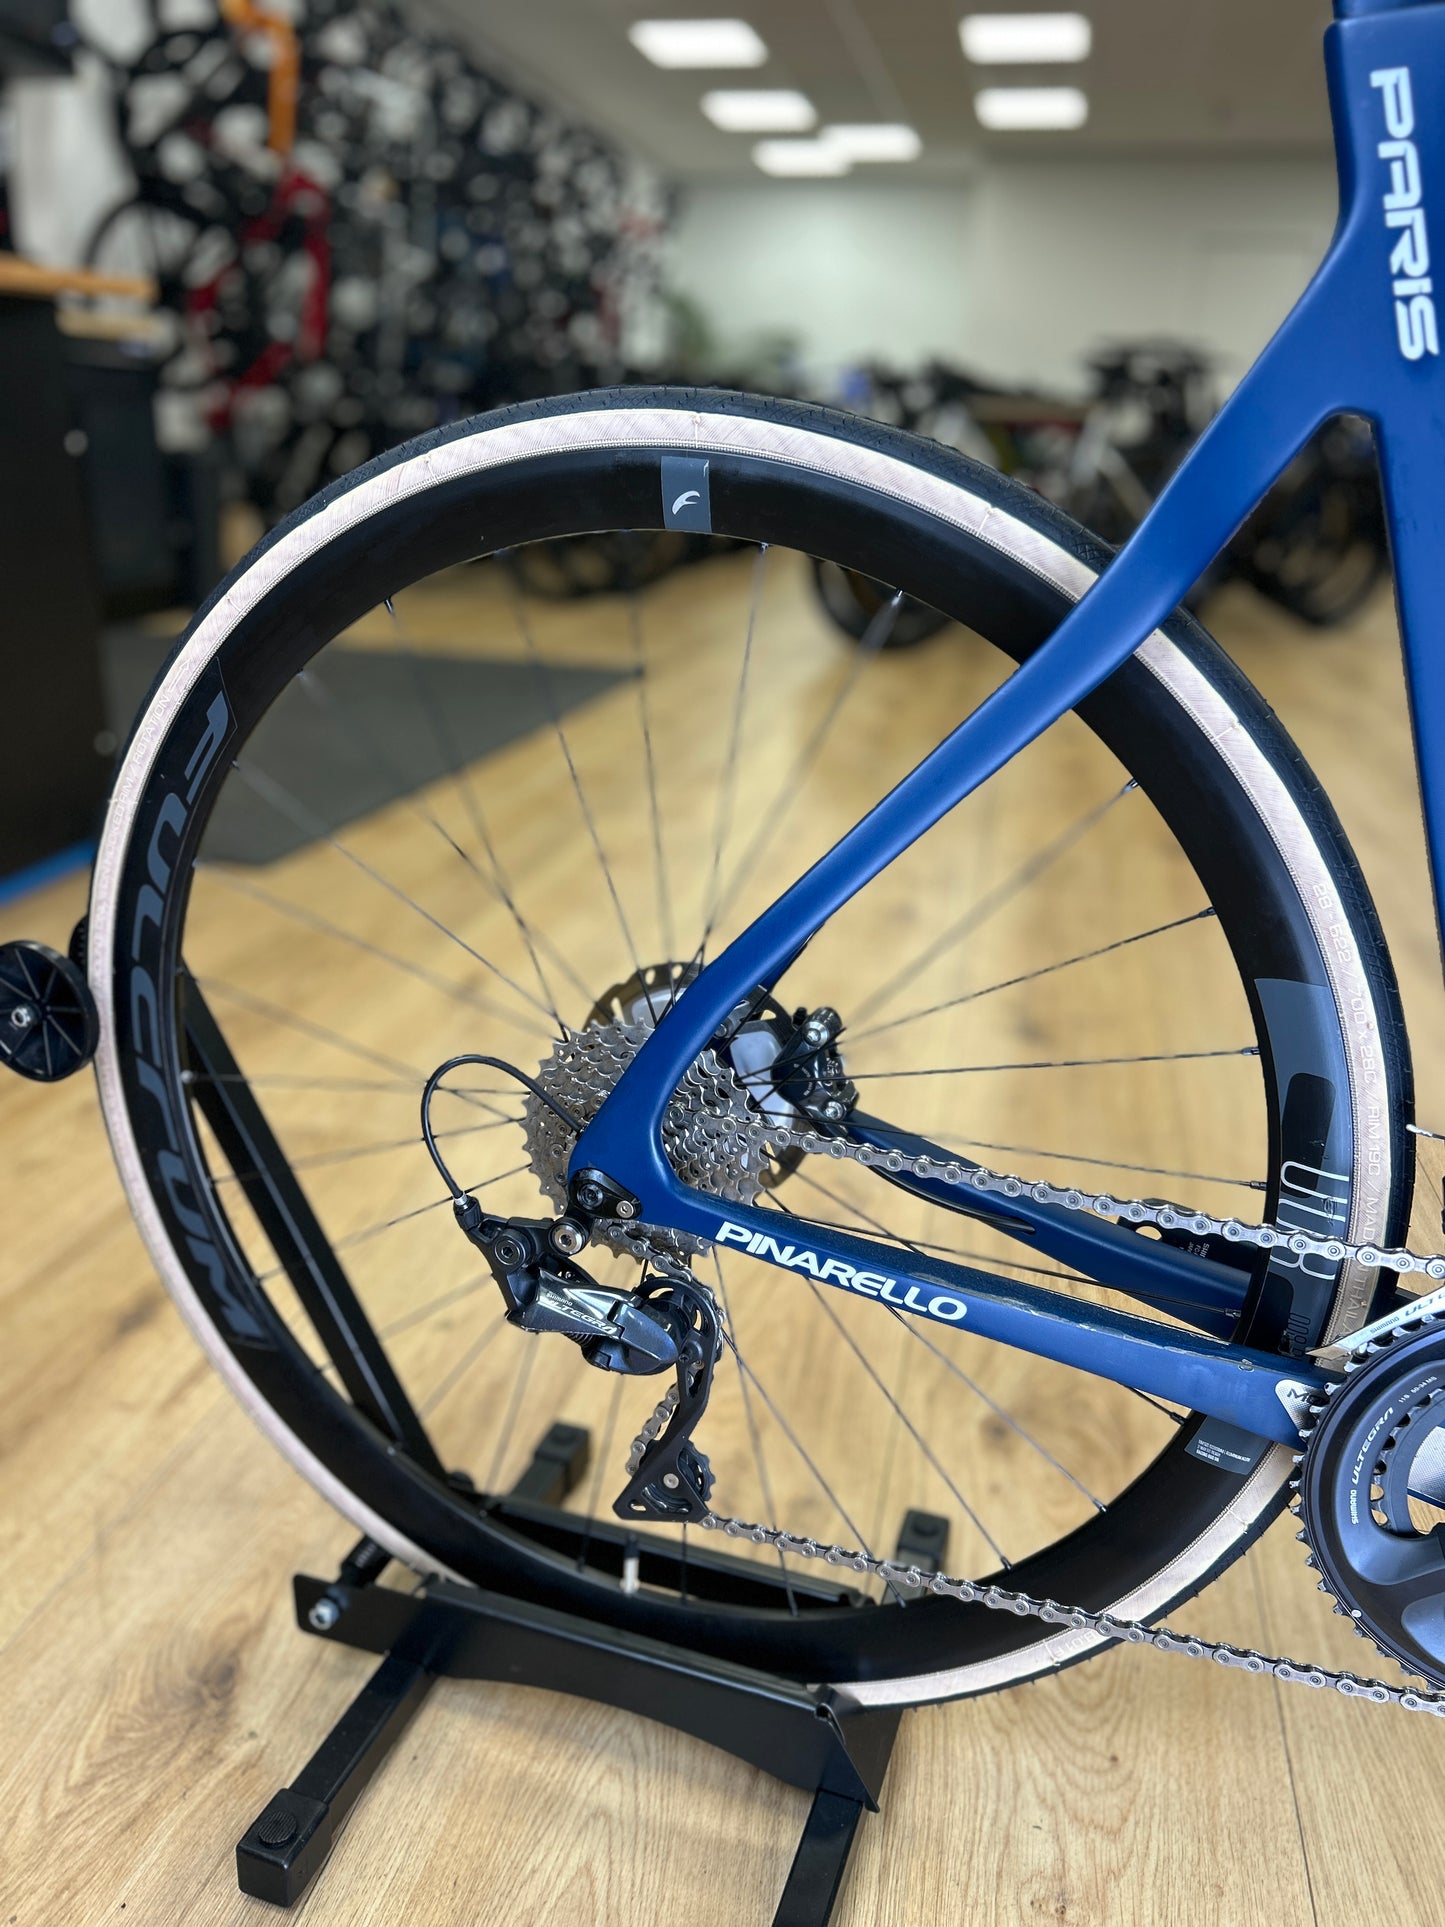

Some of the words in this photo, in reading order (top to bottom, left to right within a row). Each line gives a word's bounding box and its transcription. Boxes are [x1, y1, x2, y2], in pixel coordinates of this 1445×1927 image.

[1370, 66, 1439, 361] PARIS
[133, 694, 171, 766] ROTATION
[1313, 884, 1332, 910] 28
[1330, 925, 1352, 963] 622
[130, 690, 267, 1338] FULCRUM
[1348, 983, 1368, 1025] 700
[1360, 1045, 1377, 1084] 28C
[1366, 1104, 1380, 1141] RIM
[1368, 1145, 1382, 1177] 19C
[1362, 1197, 1380, 1242] MAD
[715, 1221, 967, 1321] PINARELLO
[1341, 1276, 1367, 1335] THAILA
[1351, 1406, 1394, 1486] ULTEGRA
